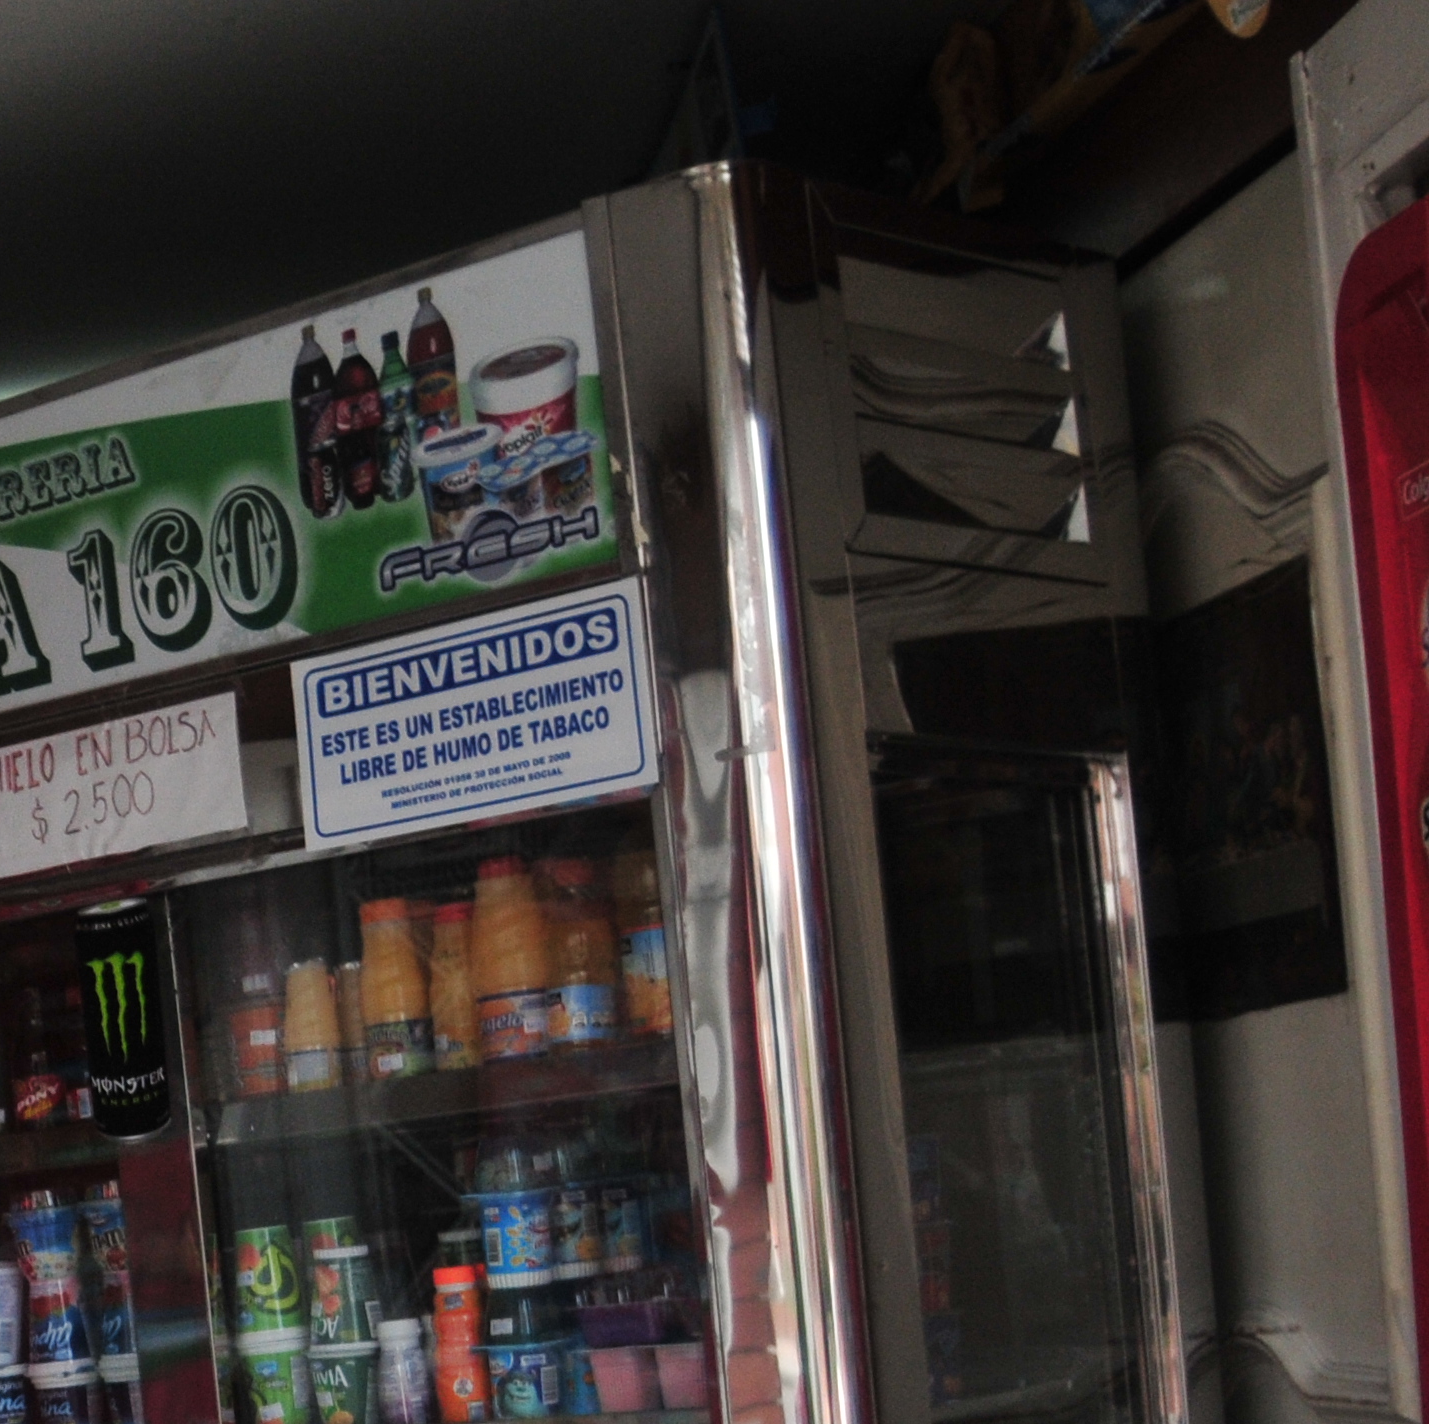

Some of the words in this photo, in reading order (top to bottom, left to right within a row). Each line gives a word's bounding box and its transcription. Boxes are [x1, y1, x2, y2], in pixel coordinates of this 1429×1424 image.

[66, 485, 299, 673] 160
[380, 505, 599, 592] FRESH
[322, 613, 615, 713] BIENVENIDOS
[74, 734, 113, 774] EN
[124, 709, 217, 766] BOLSA
[321, 727, 371, 757] ESTE
[376, 720, 400, 745] ES
[405, 712, 434, 738] UN
[440, 668, 624, 733] ESTABLECIMIENTO
[340, 753, 397, 785] LIBRE
[402, 746, 428, 772] DE
[433, 733, 492, 766] HUMO
[498, 724, 524, 752] DE
[528, 706, 610, 743] TABACO
[30, 799, 48, 842] $
[62, 770, 156, 837] 2.500
[381, 778, 442, 798] RESOLUCIÓN
[488, 766, 502, 777] DE
[503, 759, 531, 775] MAYO
[533, 756, 546, 767] DE
[391, 791, 447, 810] MINISTERIO
[449, 787, 462, 798] DE
[464, 774, 527, 796] PROTECCIÓN
[528, 767, 564, 783] SOCIAL
[90, 1066, 166, 1095] MONSTER
